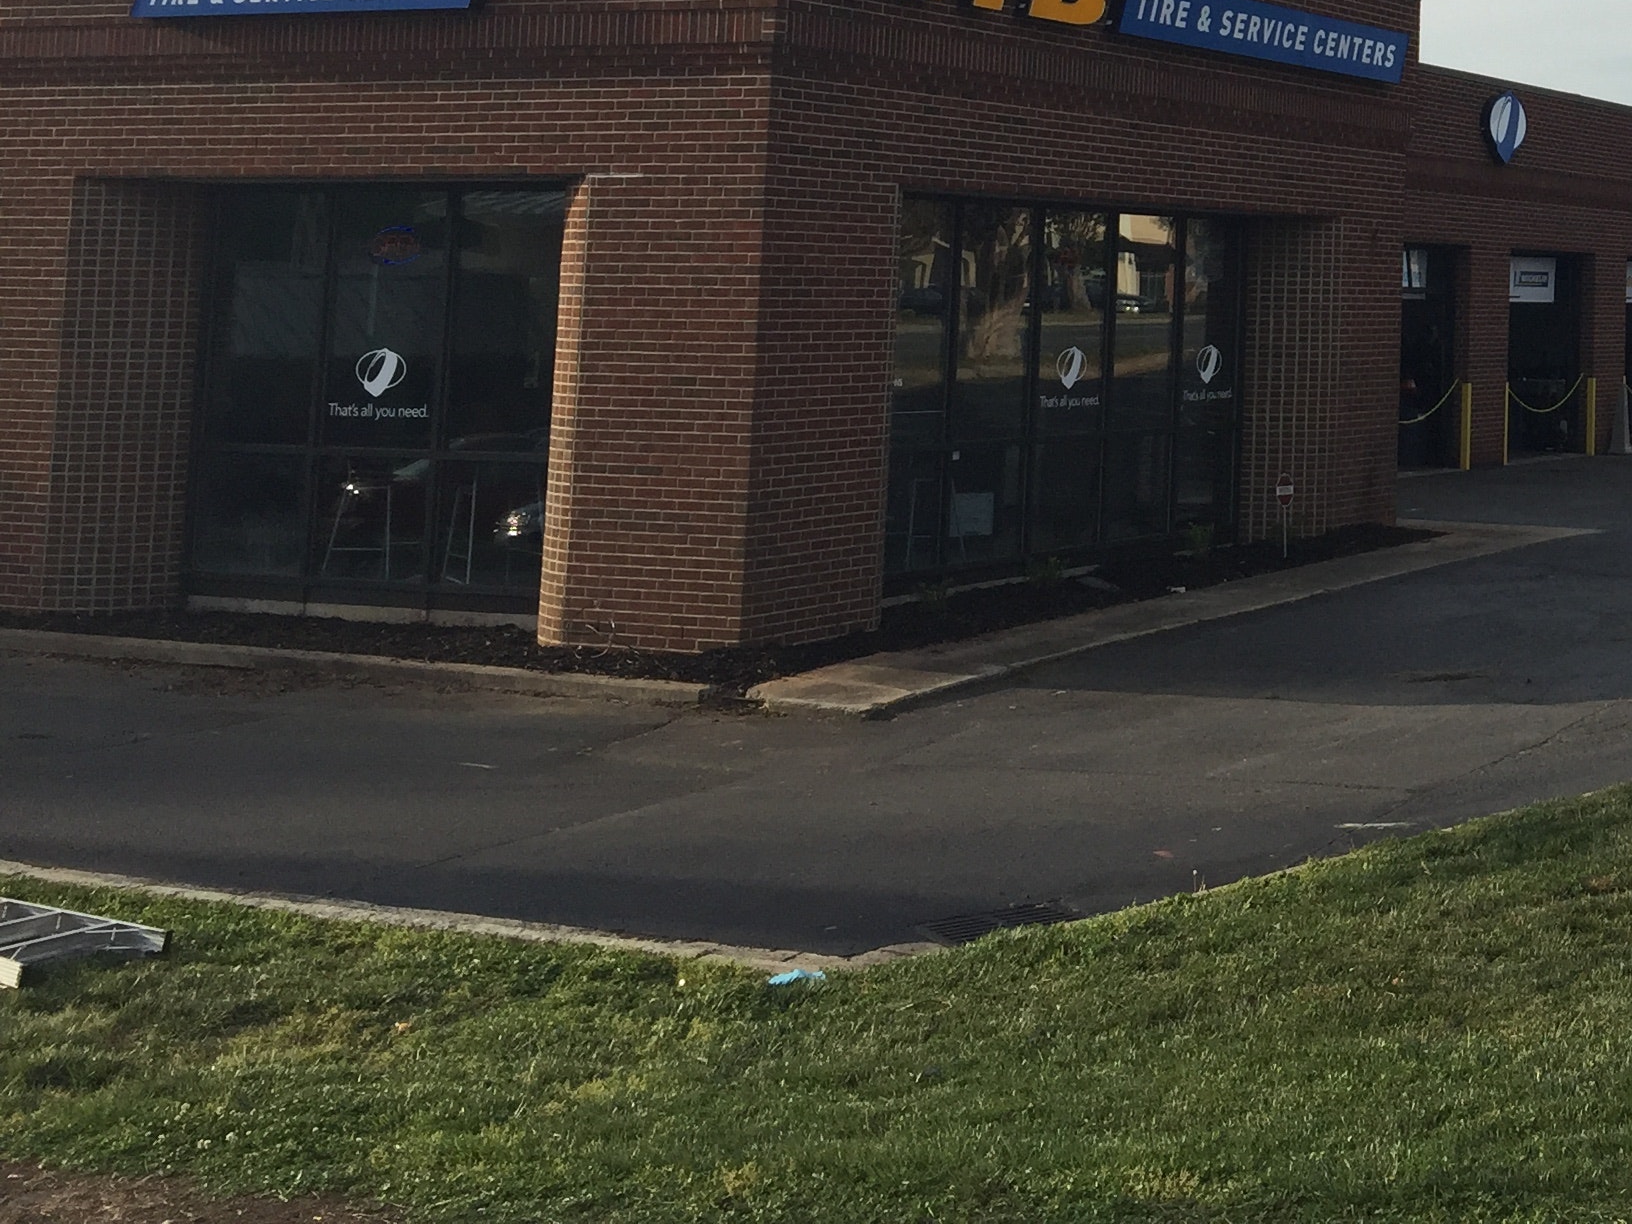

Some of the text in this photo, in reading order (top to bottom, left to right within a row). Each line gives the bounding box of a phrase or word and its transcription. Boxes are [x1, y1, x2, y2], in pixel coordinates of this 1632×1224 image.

[1196, 4, 1212, 33] &
[1218, 9, 1307, 52] SERVICE
[1312, 28, 1397, 69] CENTERS
[328, 402, 358, 417] That's
[360, 403, 373, 417] all
[374, 407, 396, 421] you
